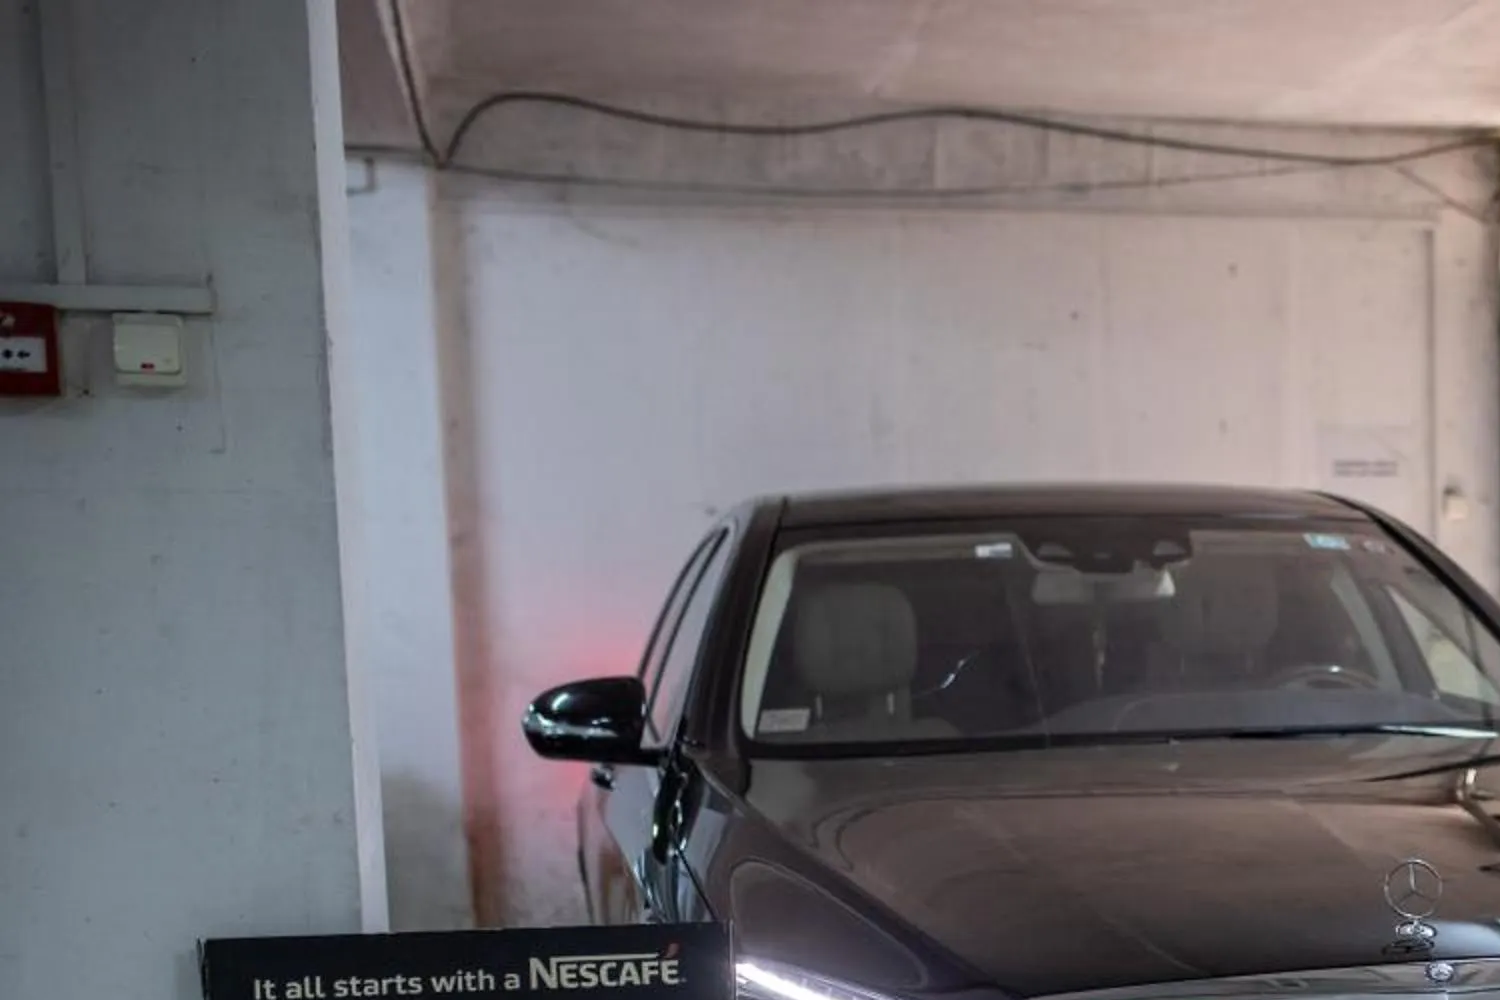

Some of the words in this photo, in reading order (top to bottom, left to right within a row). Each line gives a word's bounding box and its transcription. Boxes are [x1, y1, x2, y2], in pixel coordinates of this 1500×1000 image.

[254, 979, 277, 1000] It
[285, 975, 326, 999] all
[333, 974, 423, 998] starts
[430, 969, 495, 993] with
[504, 973, 521, 990] a
[529, 943, 680, 989] NESCAFÉ
